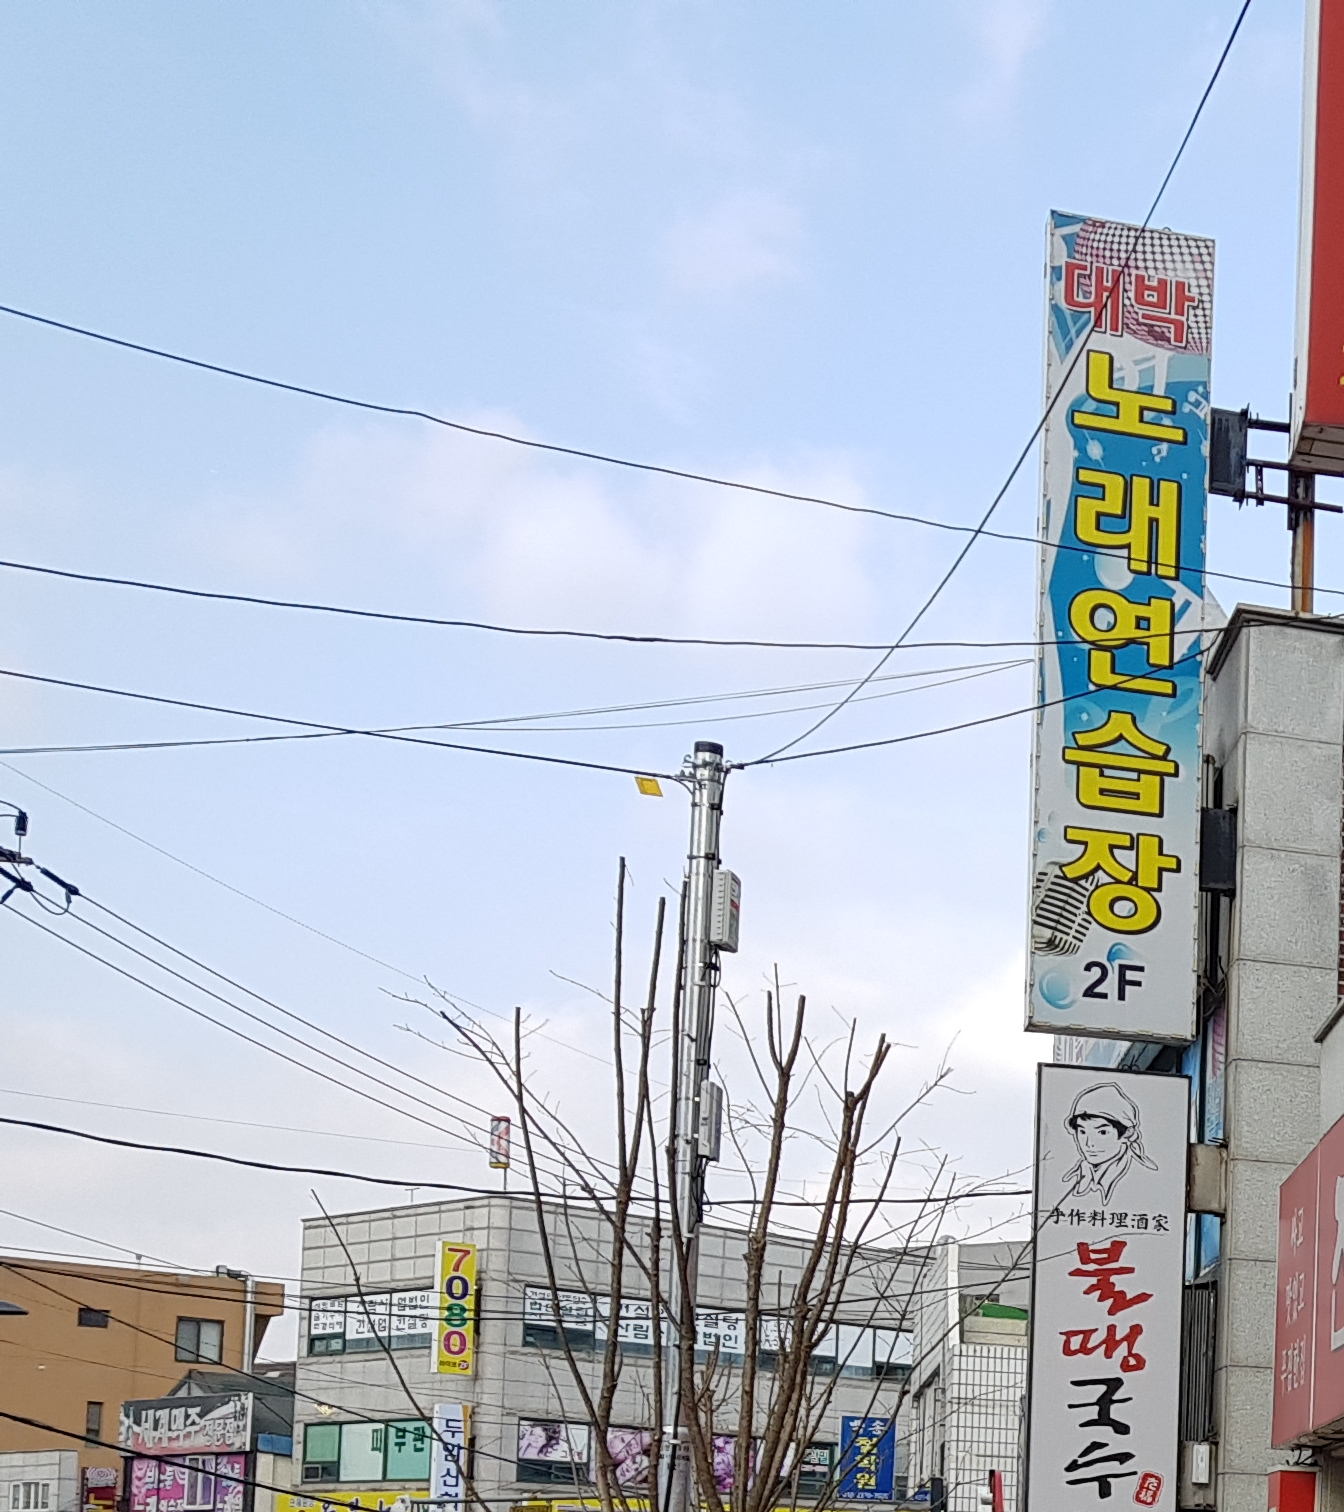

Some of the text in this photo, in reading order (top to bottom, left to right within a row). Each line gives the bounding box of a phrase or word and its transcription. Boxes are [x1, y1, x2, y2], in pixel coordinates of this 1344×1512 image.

[1063, 259, 1199, 347] 대박
[1061, 349, 1187, 934] 노래연습장
[1081, 960, 1145, 1001] 2F
[443, 1247, 471, 1356] 7080
